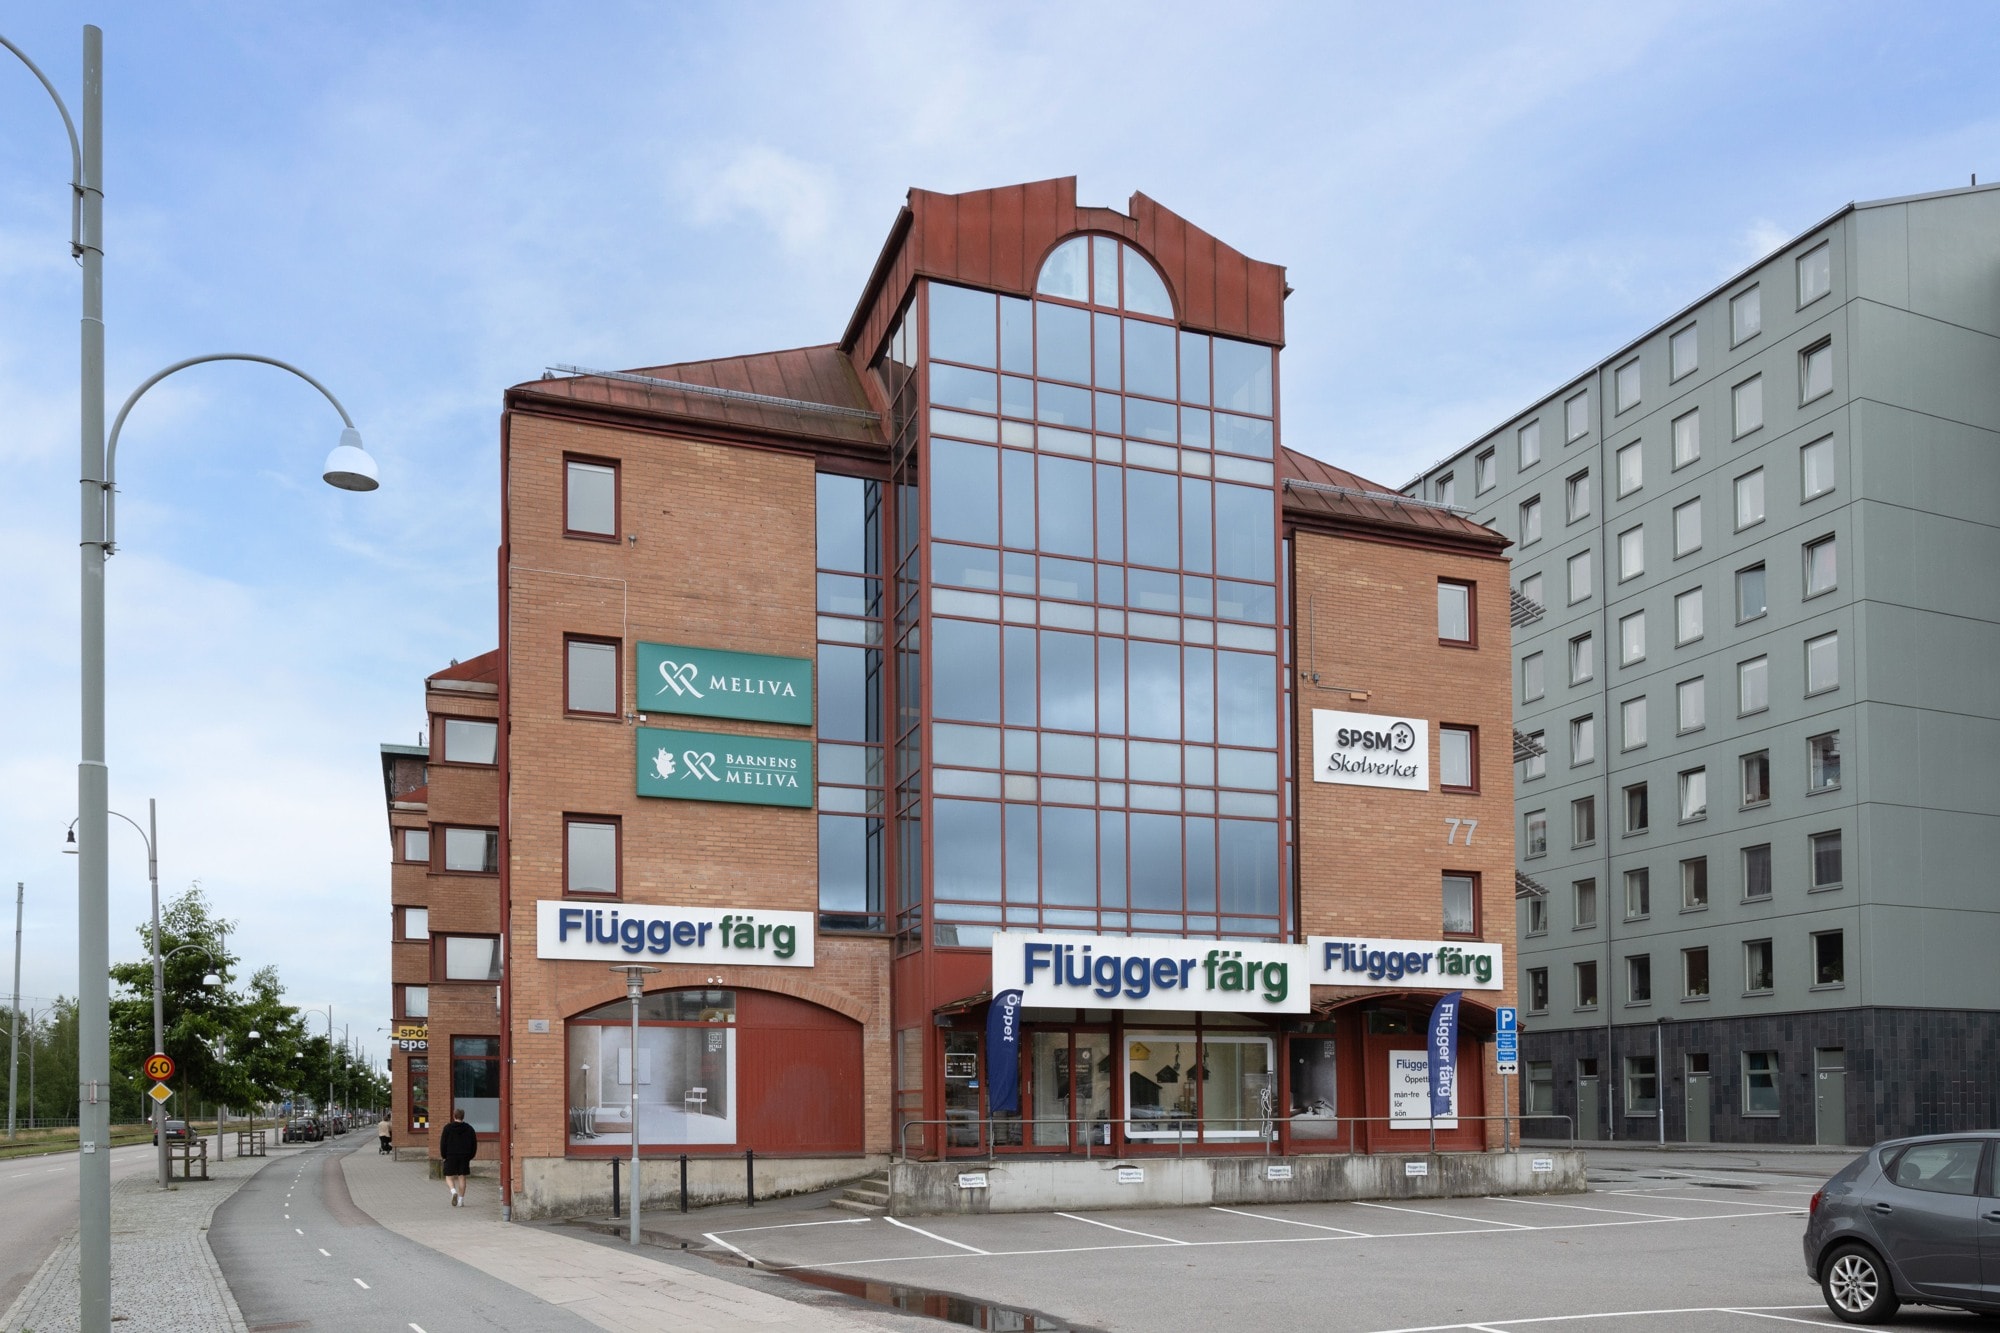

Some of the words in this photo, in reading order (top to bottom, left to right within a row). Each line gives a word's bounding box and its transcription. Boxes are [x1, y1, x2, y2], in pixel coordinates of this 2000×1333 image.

[709, 675, 797, 697] MELIVA
[1337, 727, 1392, 751] SPSM
[725, 753, 797, 769] BARNENS
[1328, 752, 1418, 778] Skolverket
[725, 770, 799, 788] MELIVA
[1445, 818, 1478, 845] 77
[559, 908, 713, 954] Flügger
[719, 915, 796, 958] färg
[1024, 942, 1197, 999] Flügger
[1203, 949, 1288, 1002] färg
[1324, 941, 1434, 981] Flügger
[1437, 946, 1492, 983] färg
[1003, 993, 1021, 1042] Öppet
[1501, 1010, 1513, 1029] P
[1436, 1003, 1454, 1062] Flügger
[400, 1039, 428, 1051] spe
[149, 1061, 170, 1074] 60
[1396, 1059, 1428, 1071] Flügge
[1404, 1074, 1430, 1084] Öppett
[1437, 1064, 1454, 1097] färg
